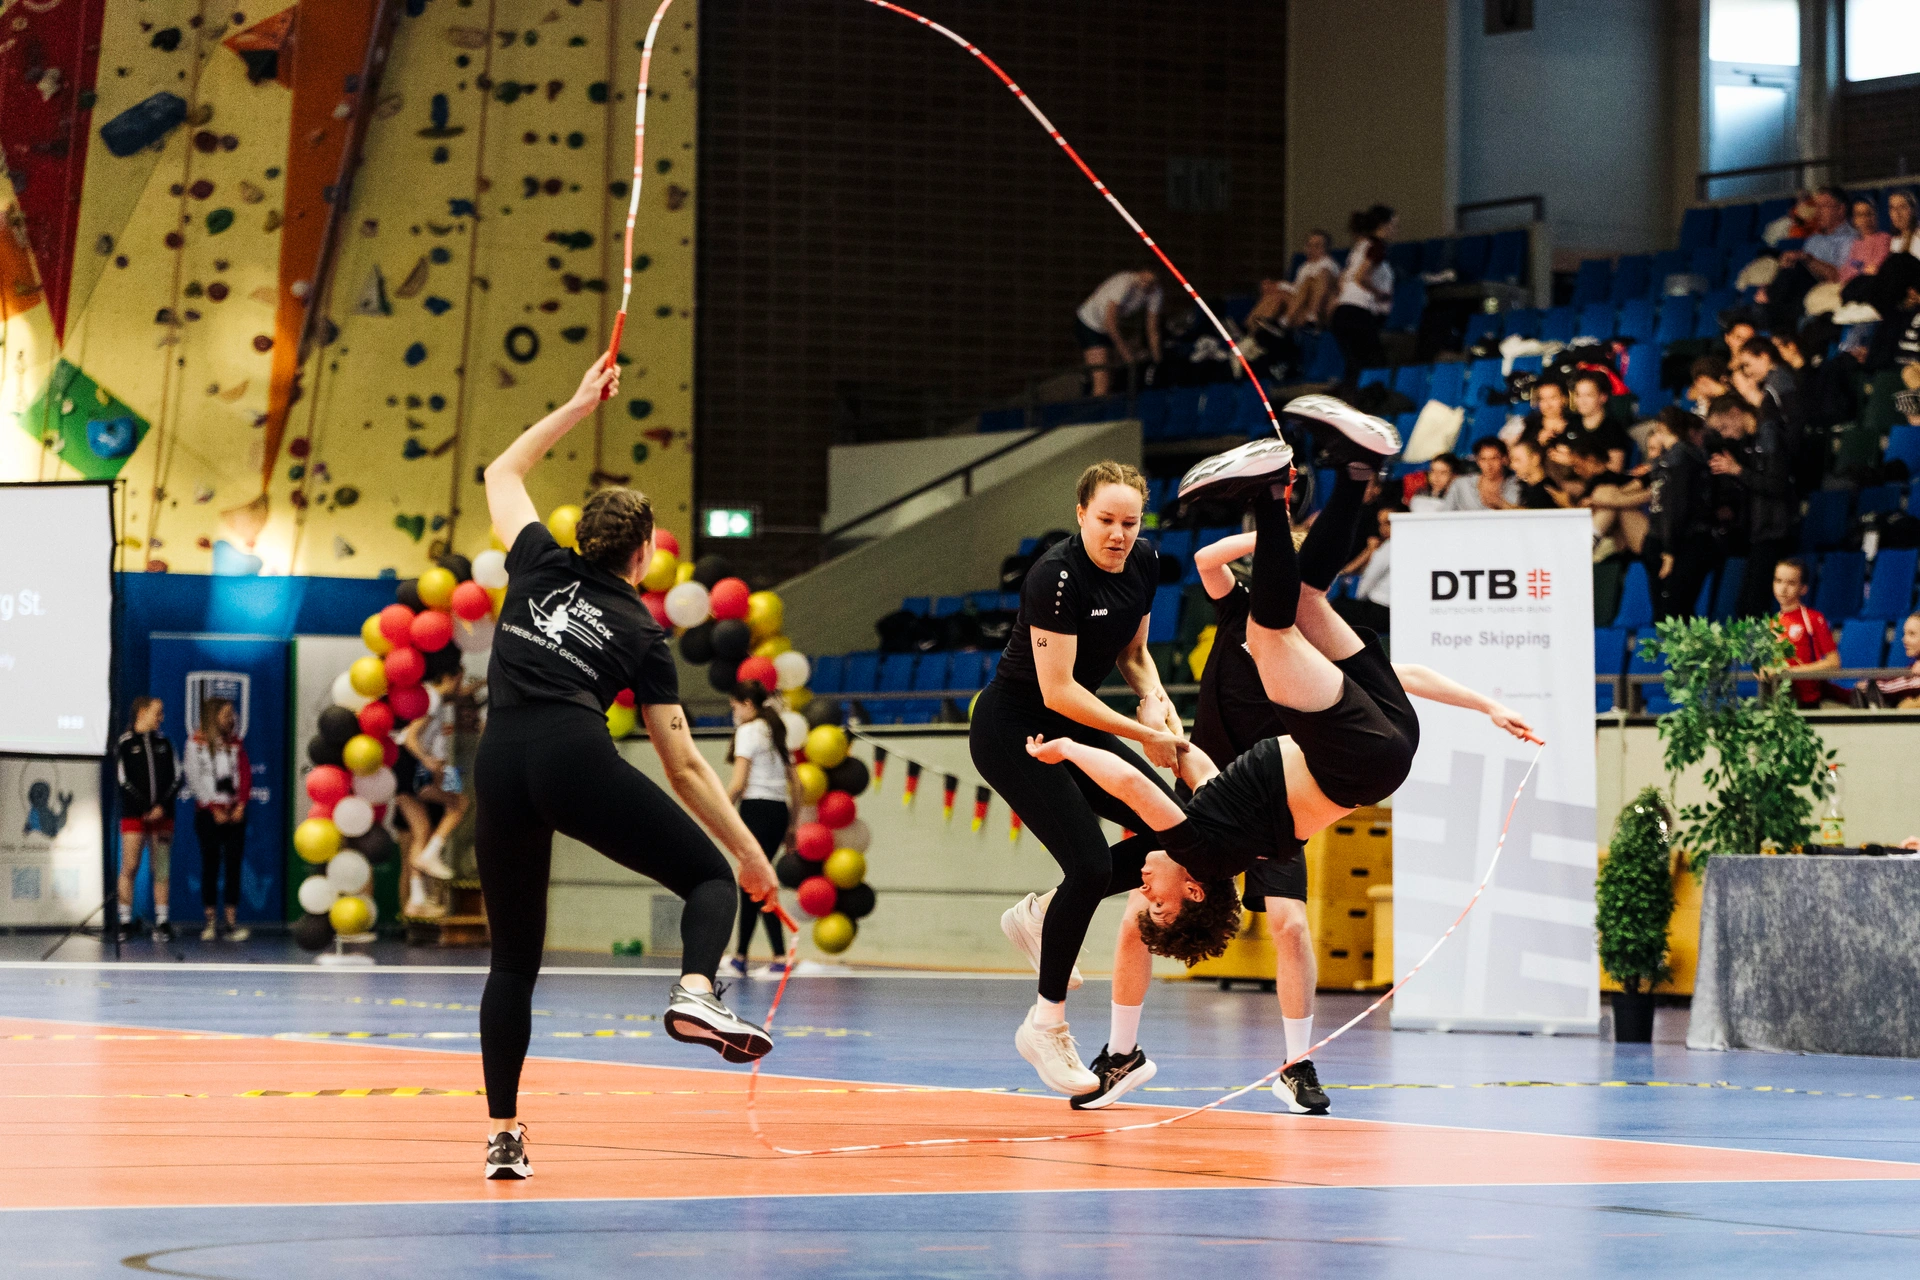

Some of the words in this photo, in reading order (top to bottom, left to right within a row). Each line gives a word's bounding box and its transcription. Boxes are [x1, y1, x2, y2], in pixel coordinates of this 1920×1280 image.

[1431, 569, 1517, 600] DTB
[576, 598, 603, 617] SKIP
[1090, 608, 1108, 617] JAKO
[568, 606, 614, 640] ATTACK
[1036, 637, 1048, 648] 68
[1431, 631, 1473, 650] Rope
[1479, 630, 1551, 650] Skipping
[509, 625, 546, 647] FREIBURG
[546, 642, 559, 653] ST.
[558, 648, 599, 680] GEORGEN
